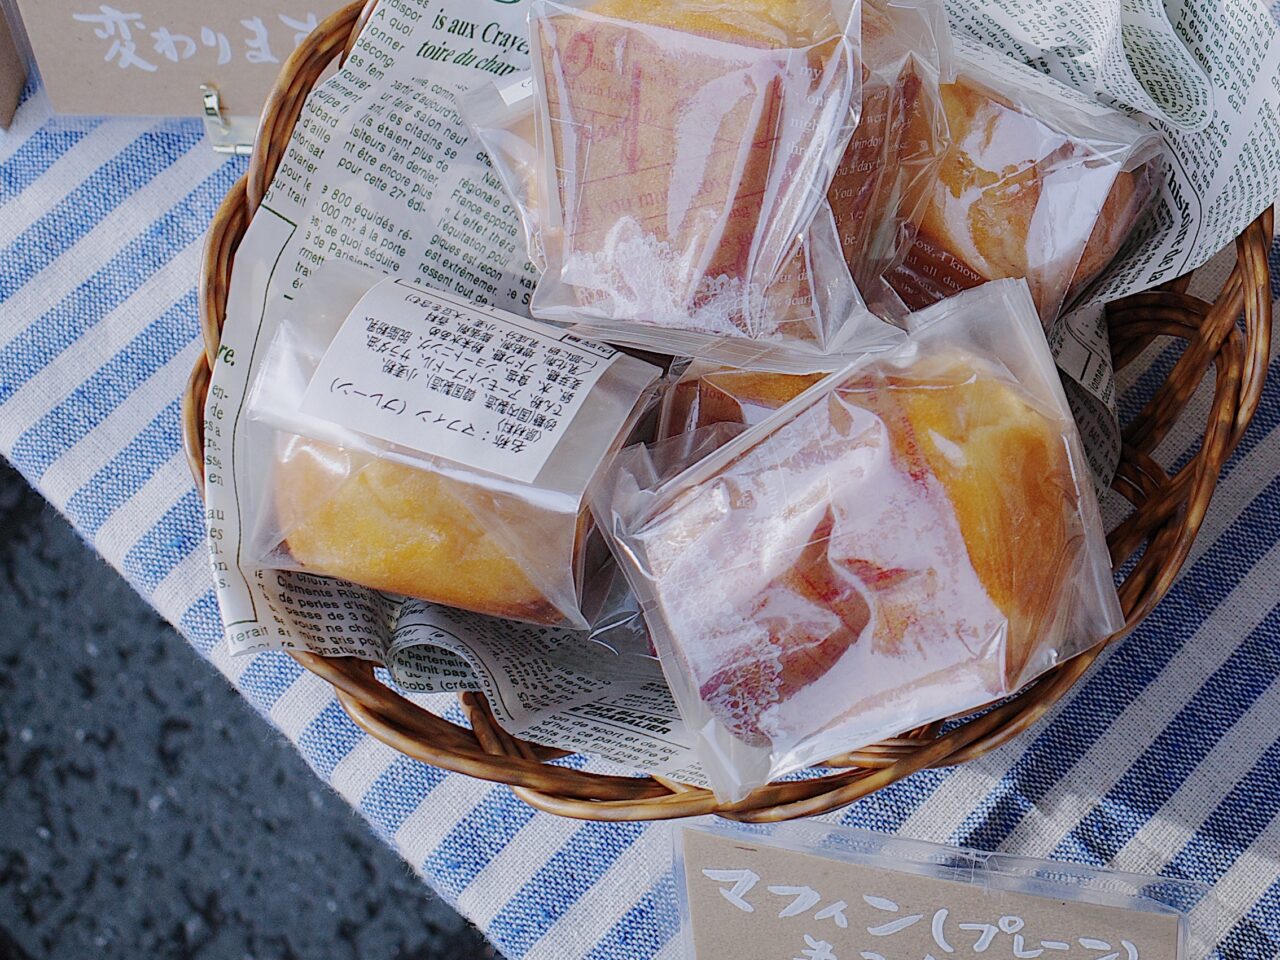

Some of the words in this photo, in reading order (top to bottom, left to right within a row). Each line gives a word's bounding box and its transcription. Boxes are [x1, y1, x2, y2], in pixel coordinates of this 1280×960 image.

[448, 20, 478, 38] aux
[453, 50, 475, 66] du
[387, 110, 402, 125] les
[405, 123, 442, 150] citadins
[444, 148, 457, 159] se
[414, 111, 441, 131] salon
[444, 129, 468, 146] neuf
[378, 123, 412, 150] étaient
[412, 147, 433, 163] plus
[436, 160, 448, 172] de
[337, 158, 362, 174] pour
[364, 173, 387, 191] cette
[358, 147, 376, 165] être
[380, 164, 410, 186] encore
[411, 183, 432, 200] plus
[331, 189, 352, 207] 800
[355, 205, 394, 232] équidés
[451, 190, 482, 214] France
[483, 212, 517, 236] apporte
[325, 225, 337, 237] de
[340, 234, 361, 251] quoi
[365, 247, 399, 271] séduire
[369, 230, 378, 242] la
[381, 239, 405, 256] porte
[425, 249, 441, 262] est
[430, 235, 460, 256] giques
[462, 253, 477, 266] est
[419, 263, 453, 287] ressent
[455, 282, 473, 299] tout
